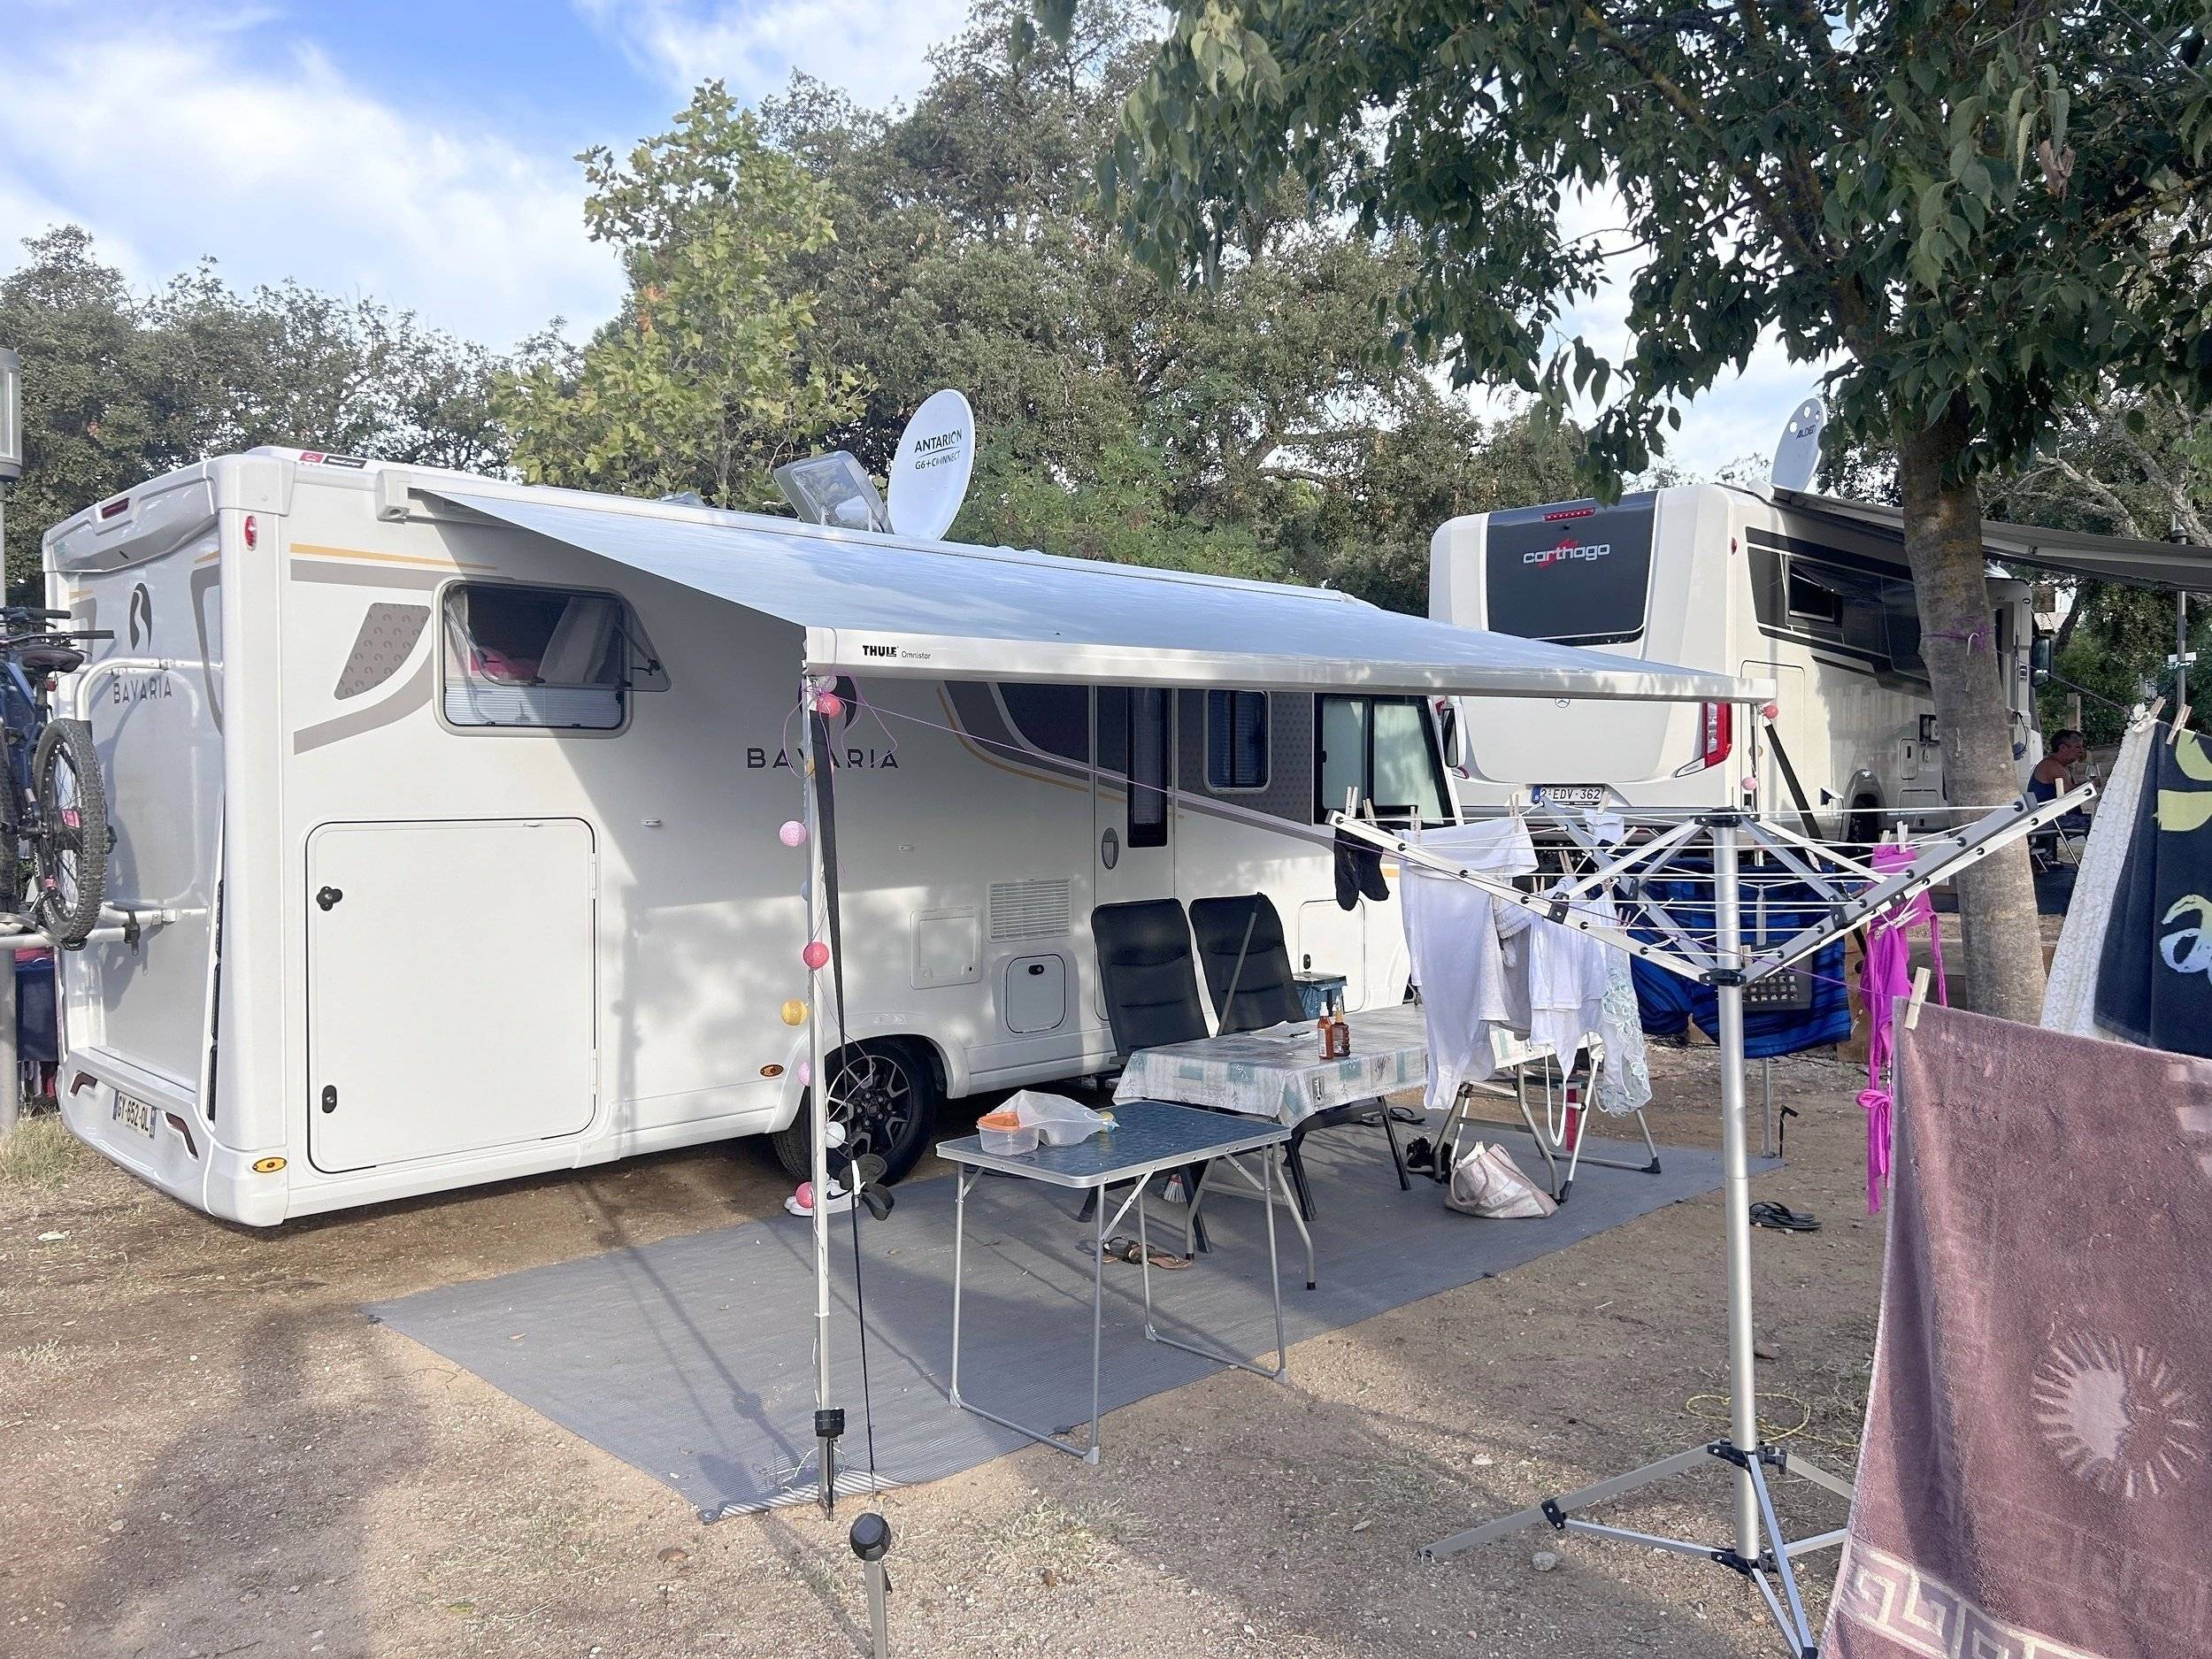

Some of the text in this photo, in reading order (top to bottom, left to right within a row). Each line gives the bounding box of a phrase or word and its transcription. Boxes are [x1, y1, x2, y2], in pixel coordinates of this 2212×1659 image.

[1523, 543, 1610, 564] carthago
[862, 645, 932, 660] THULE Omnistor
[113, 675, 173, 704] BAVARIA
